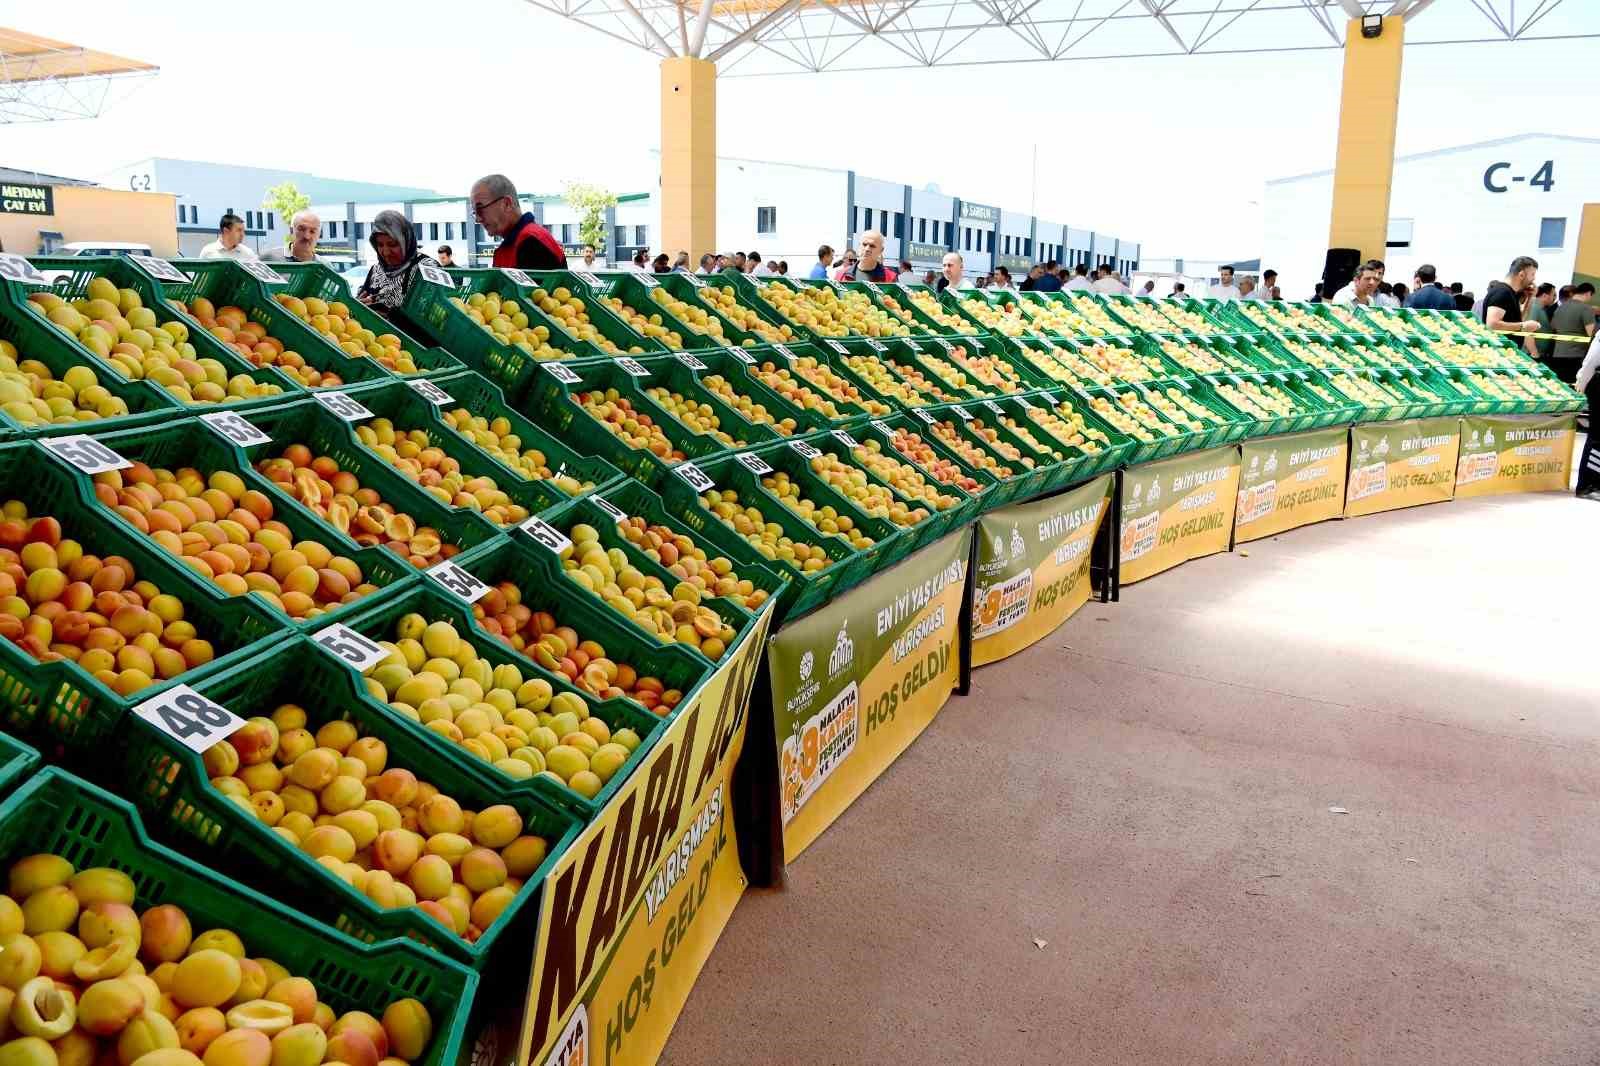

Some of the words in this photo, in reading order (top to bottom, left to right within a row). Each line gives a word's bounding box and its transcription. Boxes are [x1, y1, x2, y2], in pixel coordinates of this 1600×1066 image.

[130, 174, 151, 191] C-2
[1484, 160, 1555, 193] C-4
[2, 185, 46, 199] MEYDAN
[3, 200, 25, 212] ÇAY
[425, 265, 451, 285] 61
[550, 364, 577, 382] 62
[321, 395, 367, 416] 56
[411, 382, 449, 401] 59
[210, 421, 263, 442] 53
[54, 440, 121, 468] 50
[741, 455, 768, 471] 66
[683, 467, 708, 487] 63
[528, 521, 566, 549] 57
[1038, 520, 1051, 542] EN
[1159, 523, 1180, 547] HOŞ
[1180, 508, 1225, 538] GELDİNİZ
[435, 565, 484, 597] 54
[876, 605, 894, 638] EN
[894, 588, 910, 625] İYİ
[911, 579, 931, 613] YAŞ
[1033, 580, 1060, 612] HOŞ
[320, 628, 380, 664] 51
[893, 606, 945, 665] YARIŞMASI
[155, 693, 232, 740] 48
[820, 690, 856, 732] MALATYA
[866, 682, 899, 736] HOŞ
[820, 760, 829, 777] VE
[605, 948, 657, 1066] HOŞ
